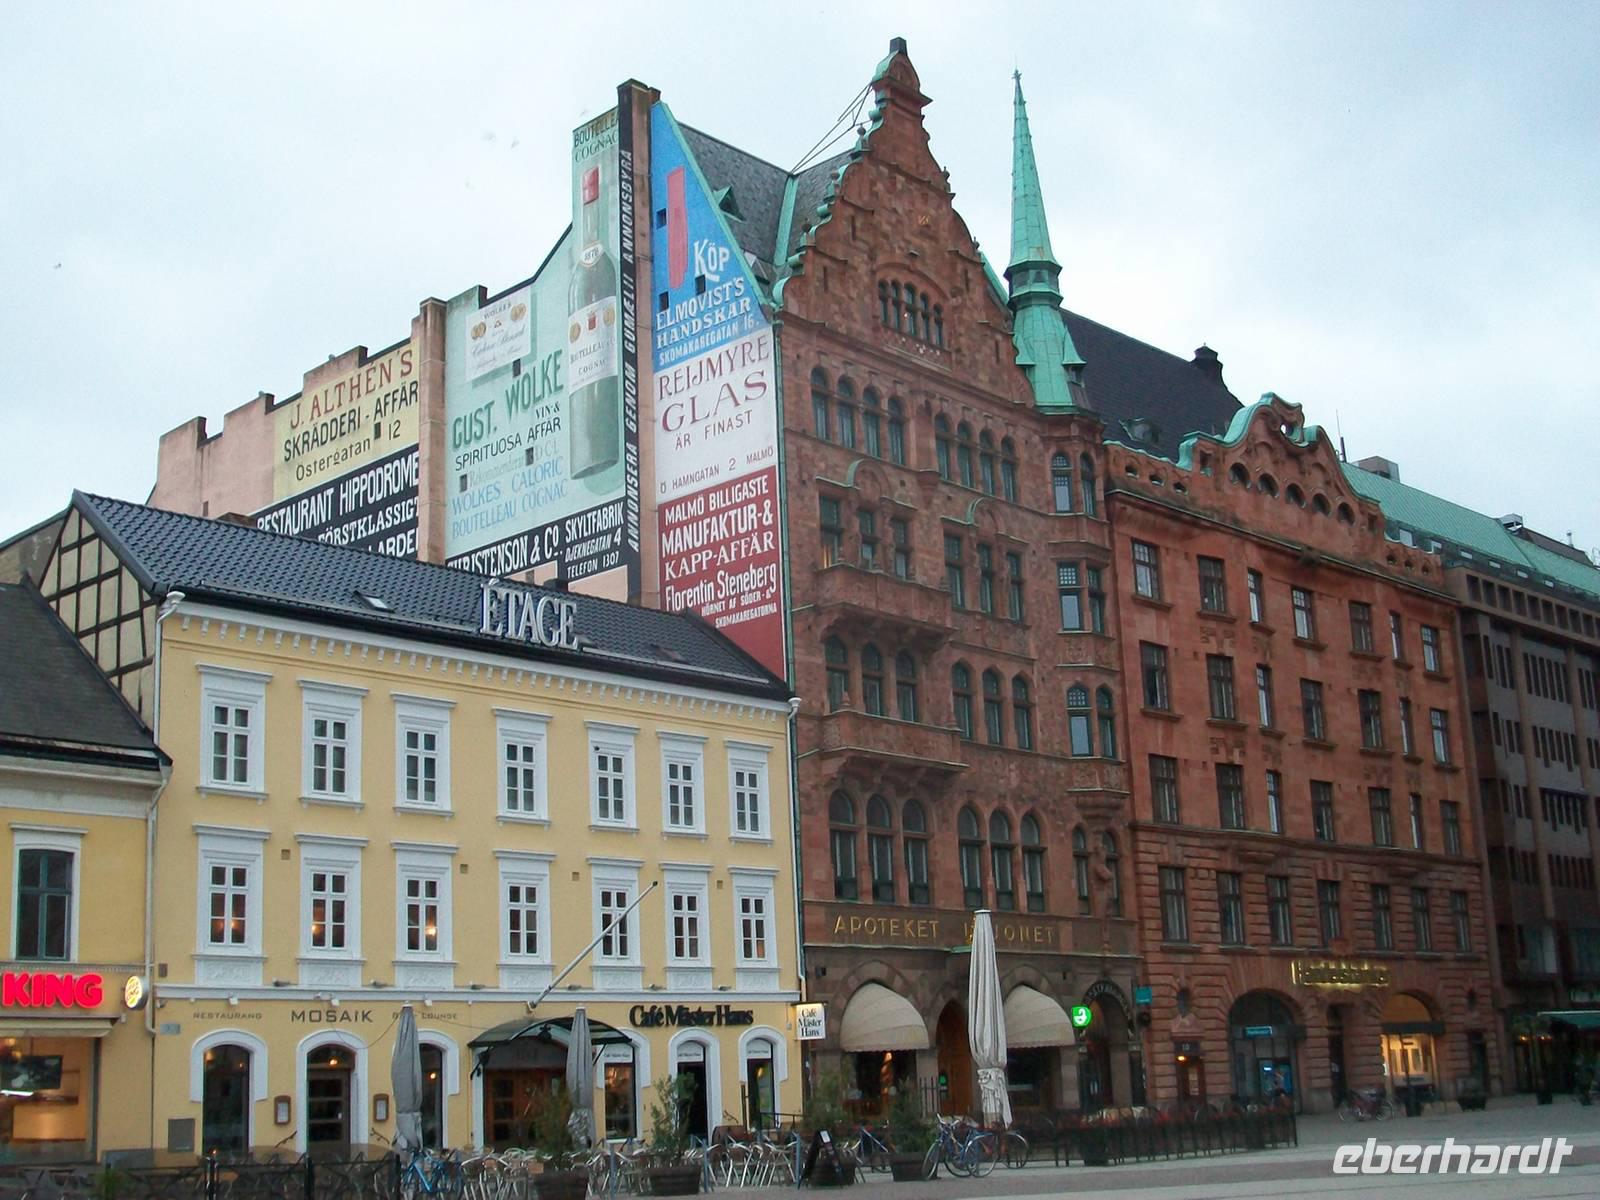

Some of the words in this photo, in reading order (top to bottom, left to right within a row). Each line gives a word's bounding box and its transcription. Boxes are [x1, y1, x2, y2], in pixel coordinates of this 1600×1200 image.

[693, 238, 730, 282] KÖP
[656, 297, 751, 349] HANDSKAR
[659, 334, 770, 401] REIJMYRE
[290, 402, 305, 430] J.
[453, 401, 499, 450] GUST.
[505, 349, 564, 422] WOLKE
[624, 361, 637, 433] GENOM
[661, 369, 768, 433] GLAS
[283, 405, 361, 463] SKRÄDDERI
[373, 379, 419, 423] AFFÄR
[387, 419, 401, 441] 12
[703, 409, 753, 441] FINAST
[454, 432, 522, 472] SPIRITUOSA
[339, 450, 419, 517] HIPPODROME
[672, 464, 720, 489] HAMNGATAN
[728, 457, 736, 472] 2
[627, 442, 639, 553] ANNONSERA
[664, 495, 704, 527] MALMÖ
[709, 475, 769, 512] BILLIGASTE
[565, 501, 624, 543] SKYLTFABRIK
[614, 527, 622, 546] 4
[530, 535, 540, 564] &
[567, 558, 598, 579] TELEFON
[602, 550, 619, 568] 1307
[664, 530, 776, 582] KAPP-AFFÄR
[665, 578, 715, 612] Florentin
[717, 562, 777, 600] Steneberg
[834, 915, 939, 939] APOTEKET
[2, 971, 104, 1009] KING
[193, 1012, 263, 1020] RESTAURANG
[629, 1004, 664, 1027] Café
[716, 1004, 754, 1026] Hans
[801, 1027, 820, 1037] Hans
